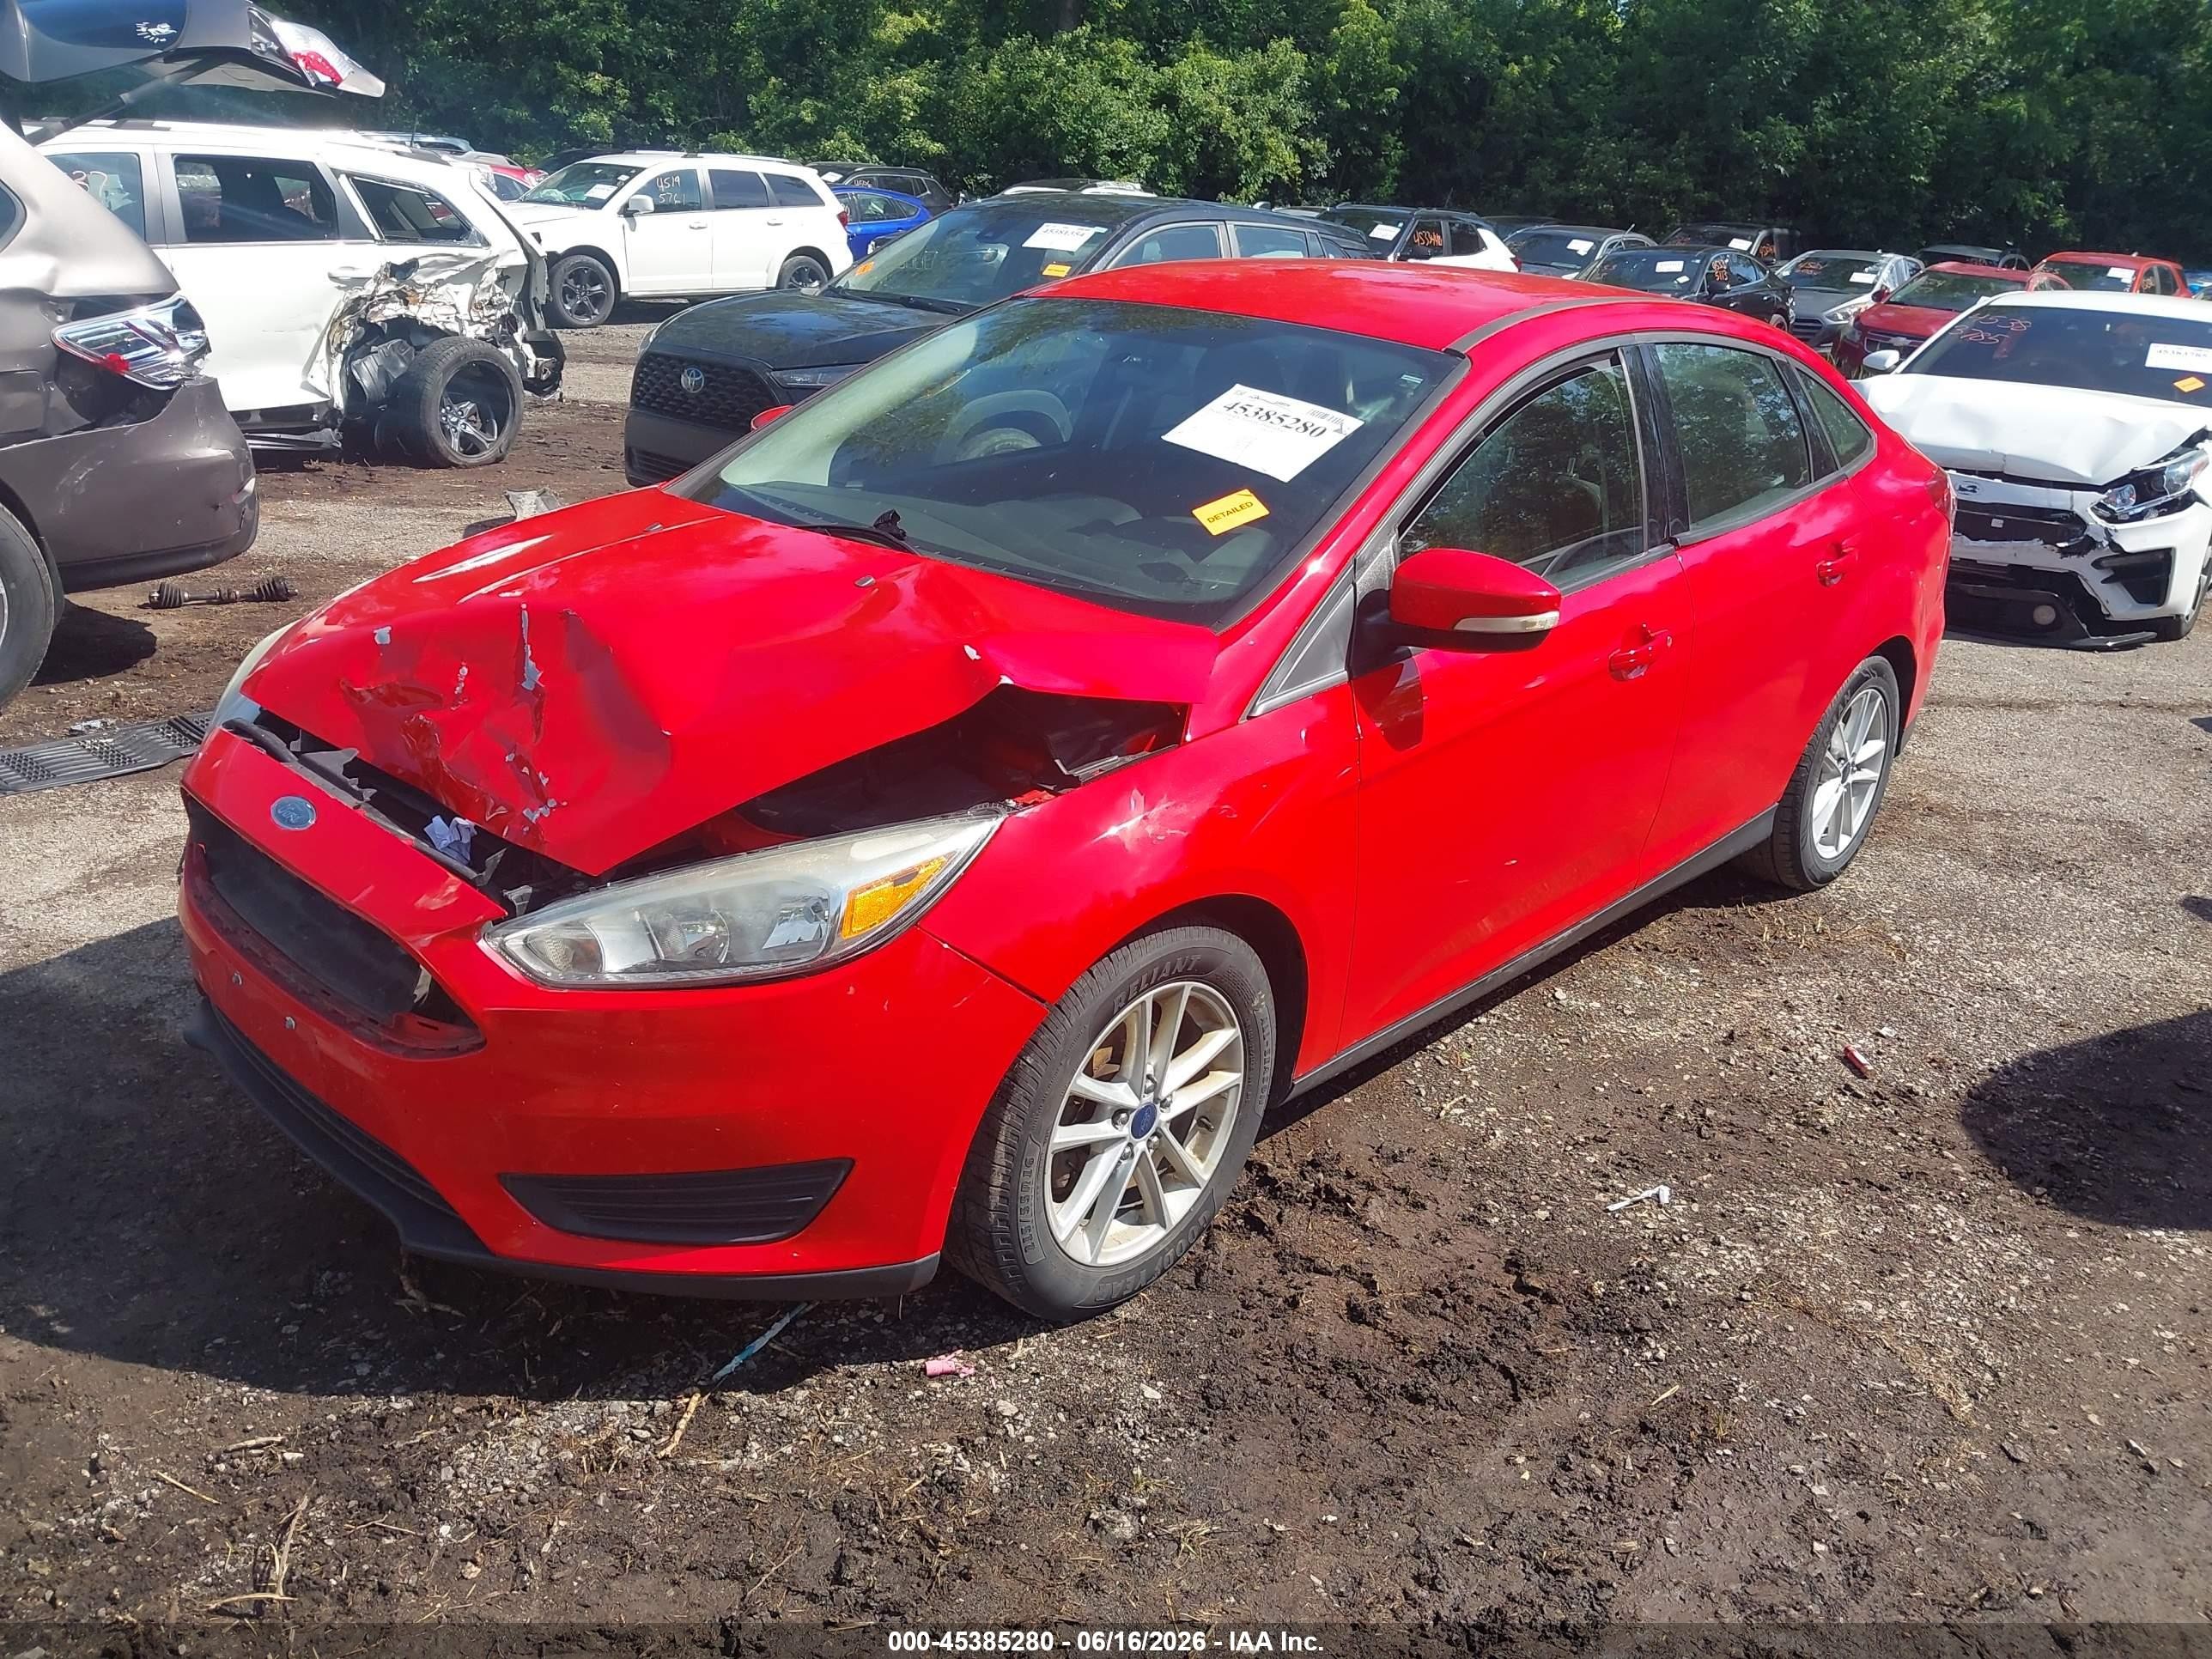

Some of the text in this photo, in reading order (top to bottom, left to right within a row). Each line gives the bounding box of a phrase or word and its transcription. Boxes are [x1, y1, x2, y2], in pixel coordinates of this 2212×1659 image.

[656, 175, 681, 192] 4519
[1223, 401, 1328, 438] 45385280
[1206, 501, 1254, 524] DETAILED
[1113, 953, 1201, 1014] RELIANT
